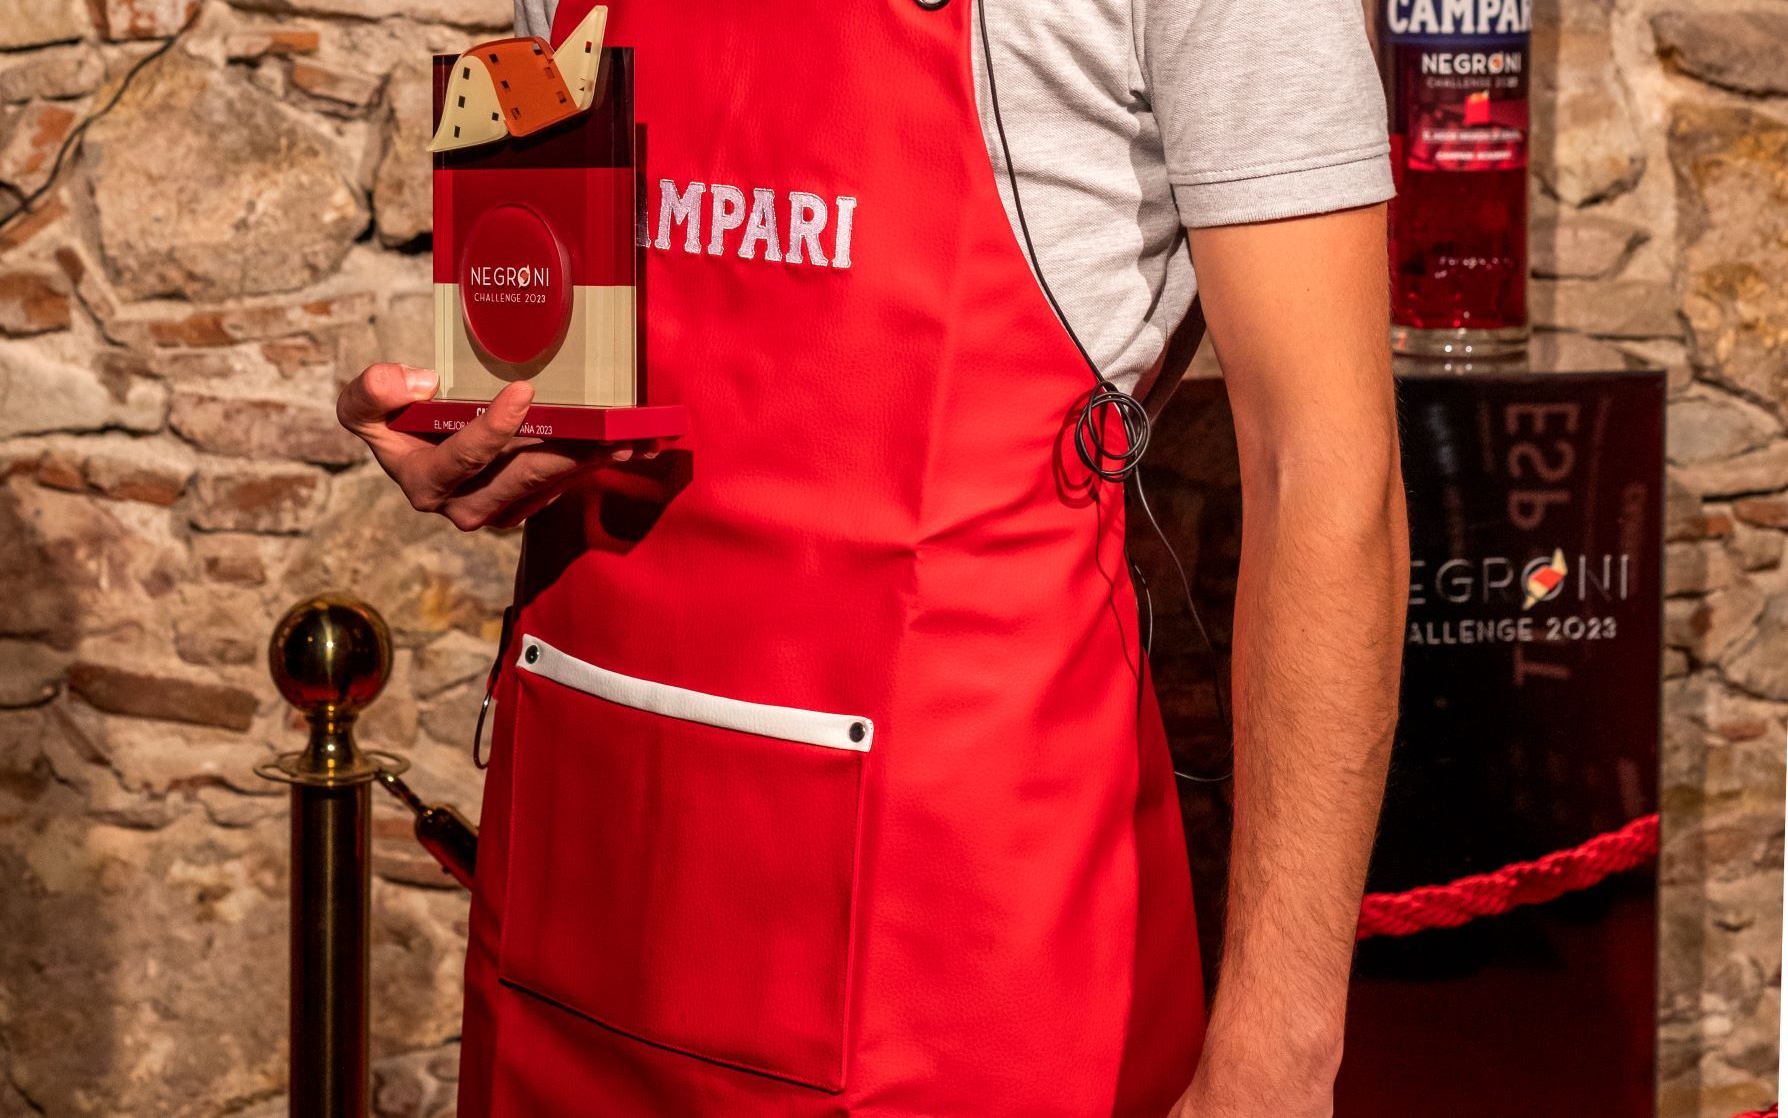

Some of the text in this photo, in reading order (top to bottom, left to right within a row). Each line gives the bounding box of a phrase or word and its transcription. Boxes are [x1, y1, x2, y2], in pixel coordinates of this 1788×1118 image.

[1421, 49, 1522, 75] NEGRONI
[635, 178, 857, 269] MPARI
[470, 264, 549, 288] NEGRONI
[474, 292, 546, 304] CHALLENGE 2023
[433, 419, 442, 430] EL
[519, 422, 535, 434] AÑA
[535, 424, 553, 435] 2023
[1408, 552, 1630, 606] EGRONI
[1408, 615, 1617, 645] ALLENGE 2023
